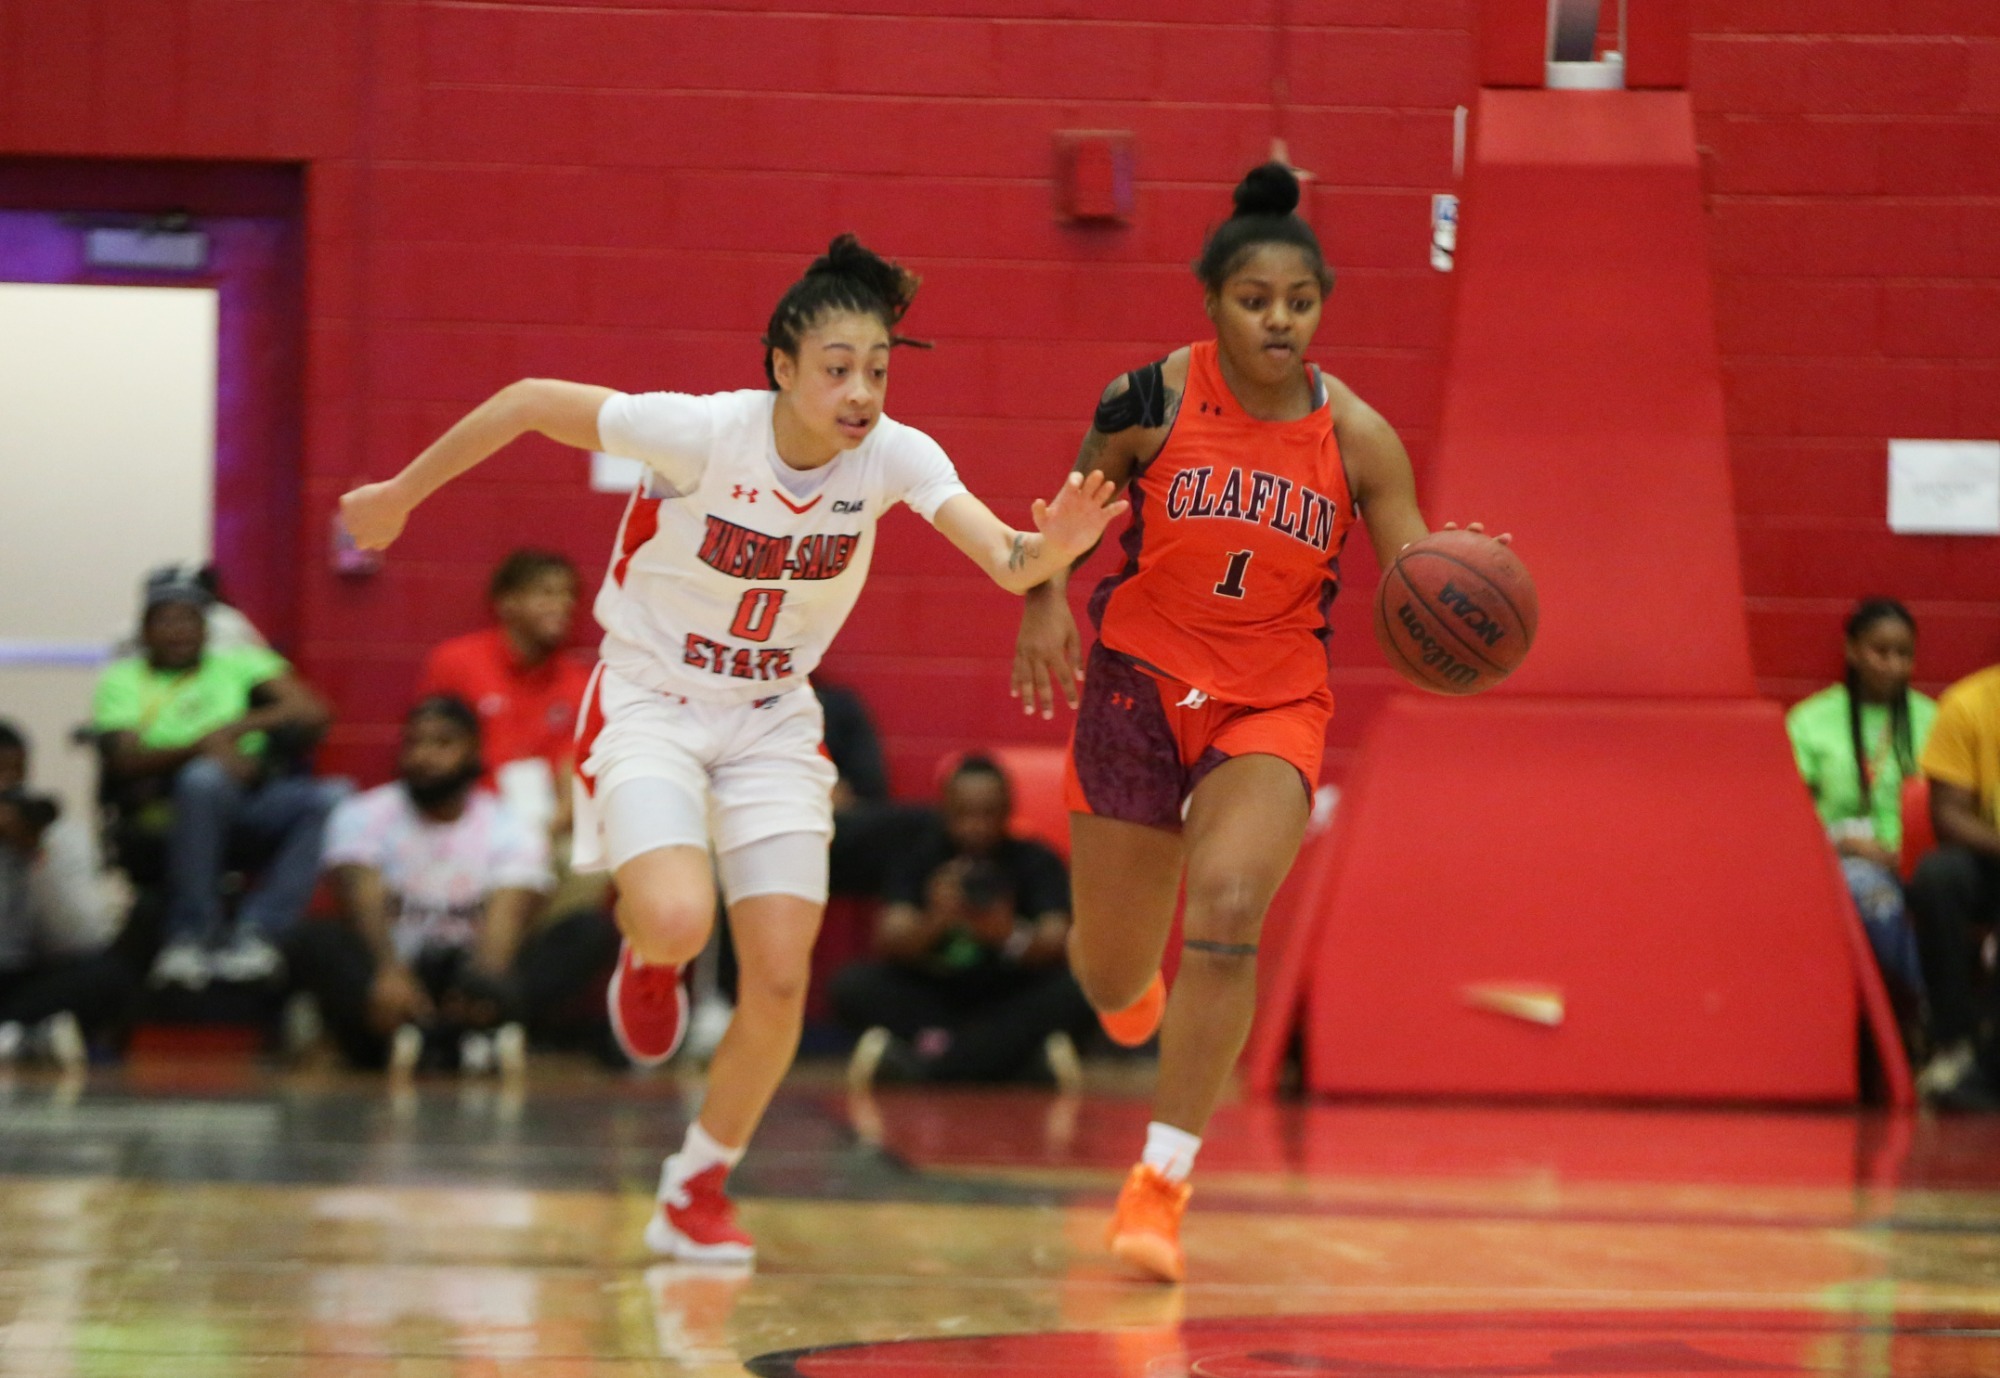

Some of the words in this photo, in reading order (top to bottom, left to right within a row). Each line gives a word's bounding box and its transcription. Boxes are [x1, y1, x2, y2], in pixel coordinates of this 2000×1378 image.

[1167, 466, 1336, 553] CLAFLIN
[1213, 549, 1253, 599] 1
[728, 588, 787, 642] 0
[1399, 602, 1479, 684] Wilson
[1438, 580, 1505, 647] NCAA
[684, 633, 793, 680] STATE
